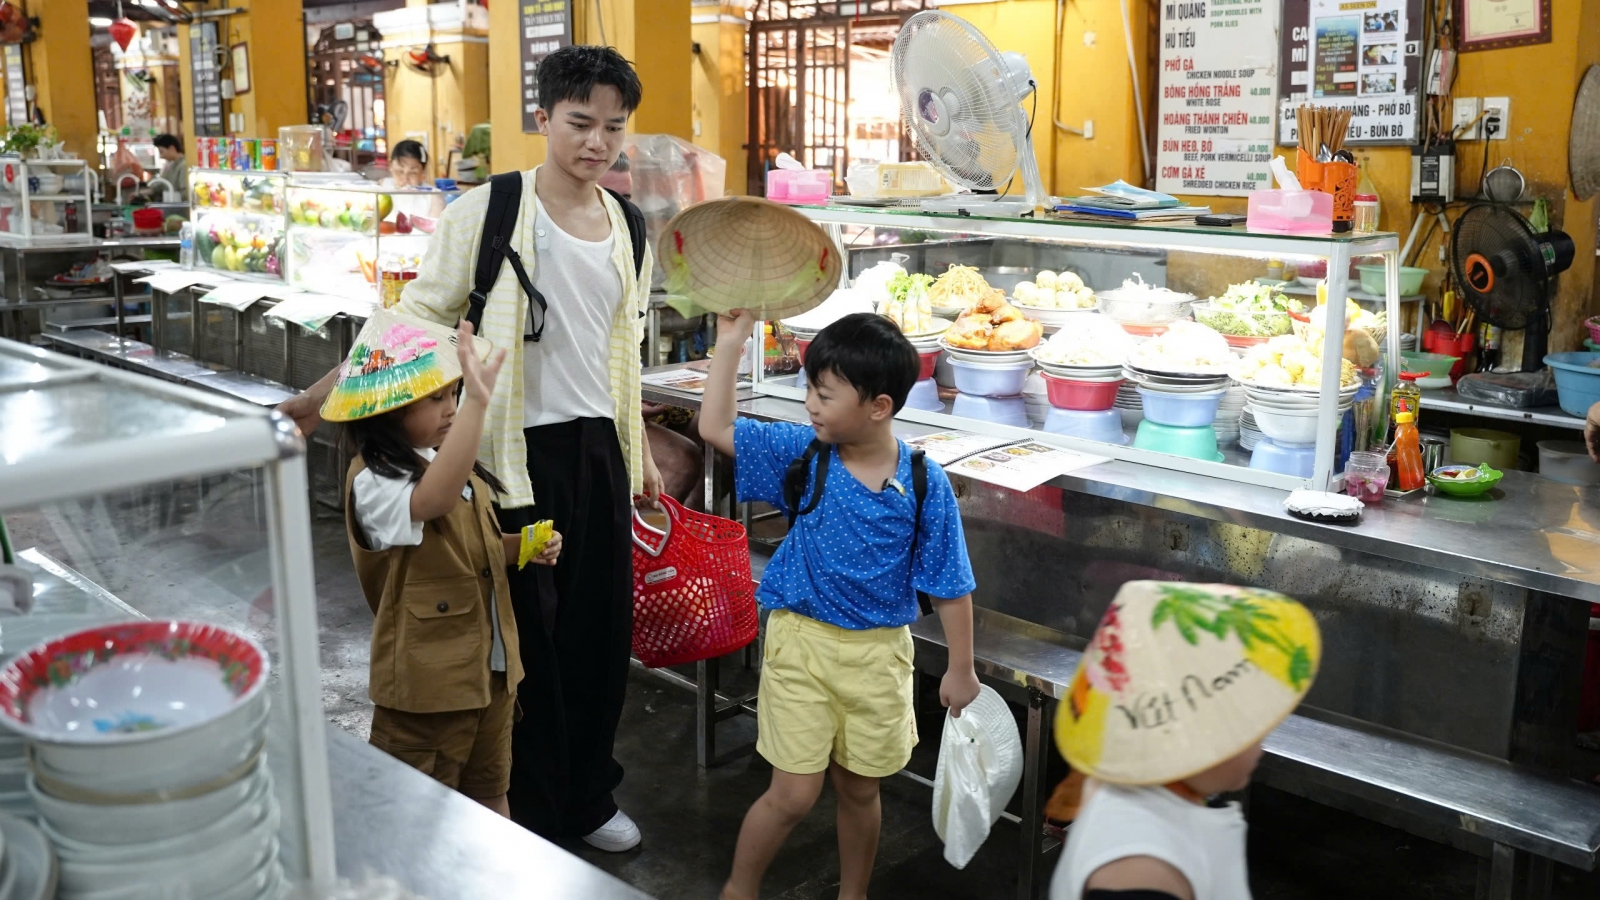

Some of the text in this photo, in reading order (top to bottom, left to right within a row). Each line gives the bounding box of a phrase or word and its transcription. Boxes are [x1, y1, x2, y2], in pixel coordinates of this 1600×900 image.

[1292, 26, 1309, 41] CA
[1292, 44, 1306, 62] MÌ
[1183, 57, 1194, 71] GÀ
[1186, 69, 1255, 79] CHICKEN NOODLE SOUP
[1250, 87, 1271, 95] 40.000
[1186, 98, 1221, 107] WHITE ROSE
[1378, 99, 1397, 116] PHỞ
[1399, 100, 1411, 116] BÒ
[1249, 116, 1270, 124] 40.000
[1184, 126, 1229, 134] FRIED WONTON
[1370, 122, 1389, 138] BÚN
[1391, 121, 1404, 137] BÒ
[1200, 153, 1216, 161] PORK
[1218, 153, 1253, 162] VERMICELLI
[1255, 154, 1271, 162] SOUP
[1182, 165, 1193, 179] GÀ
[1247, 173, 1267, 181] 40.000
[1183, 180, 1256, 190] SHREDDED CHICKEN RICE
[1181, 658, 1251, 712] Nam
